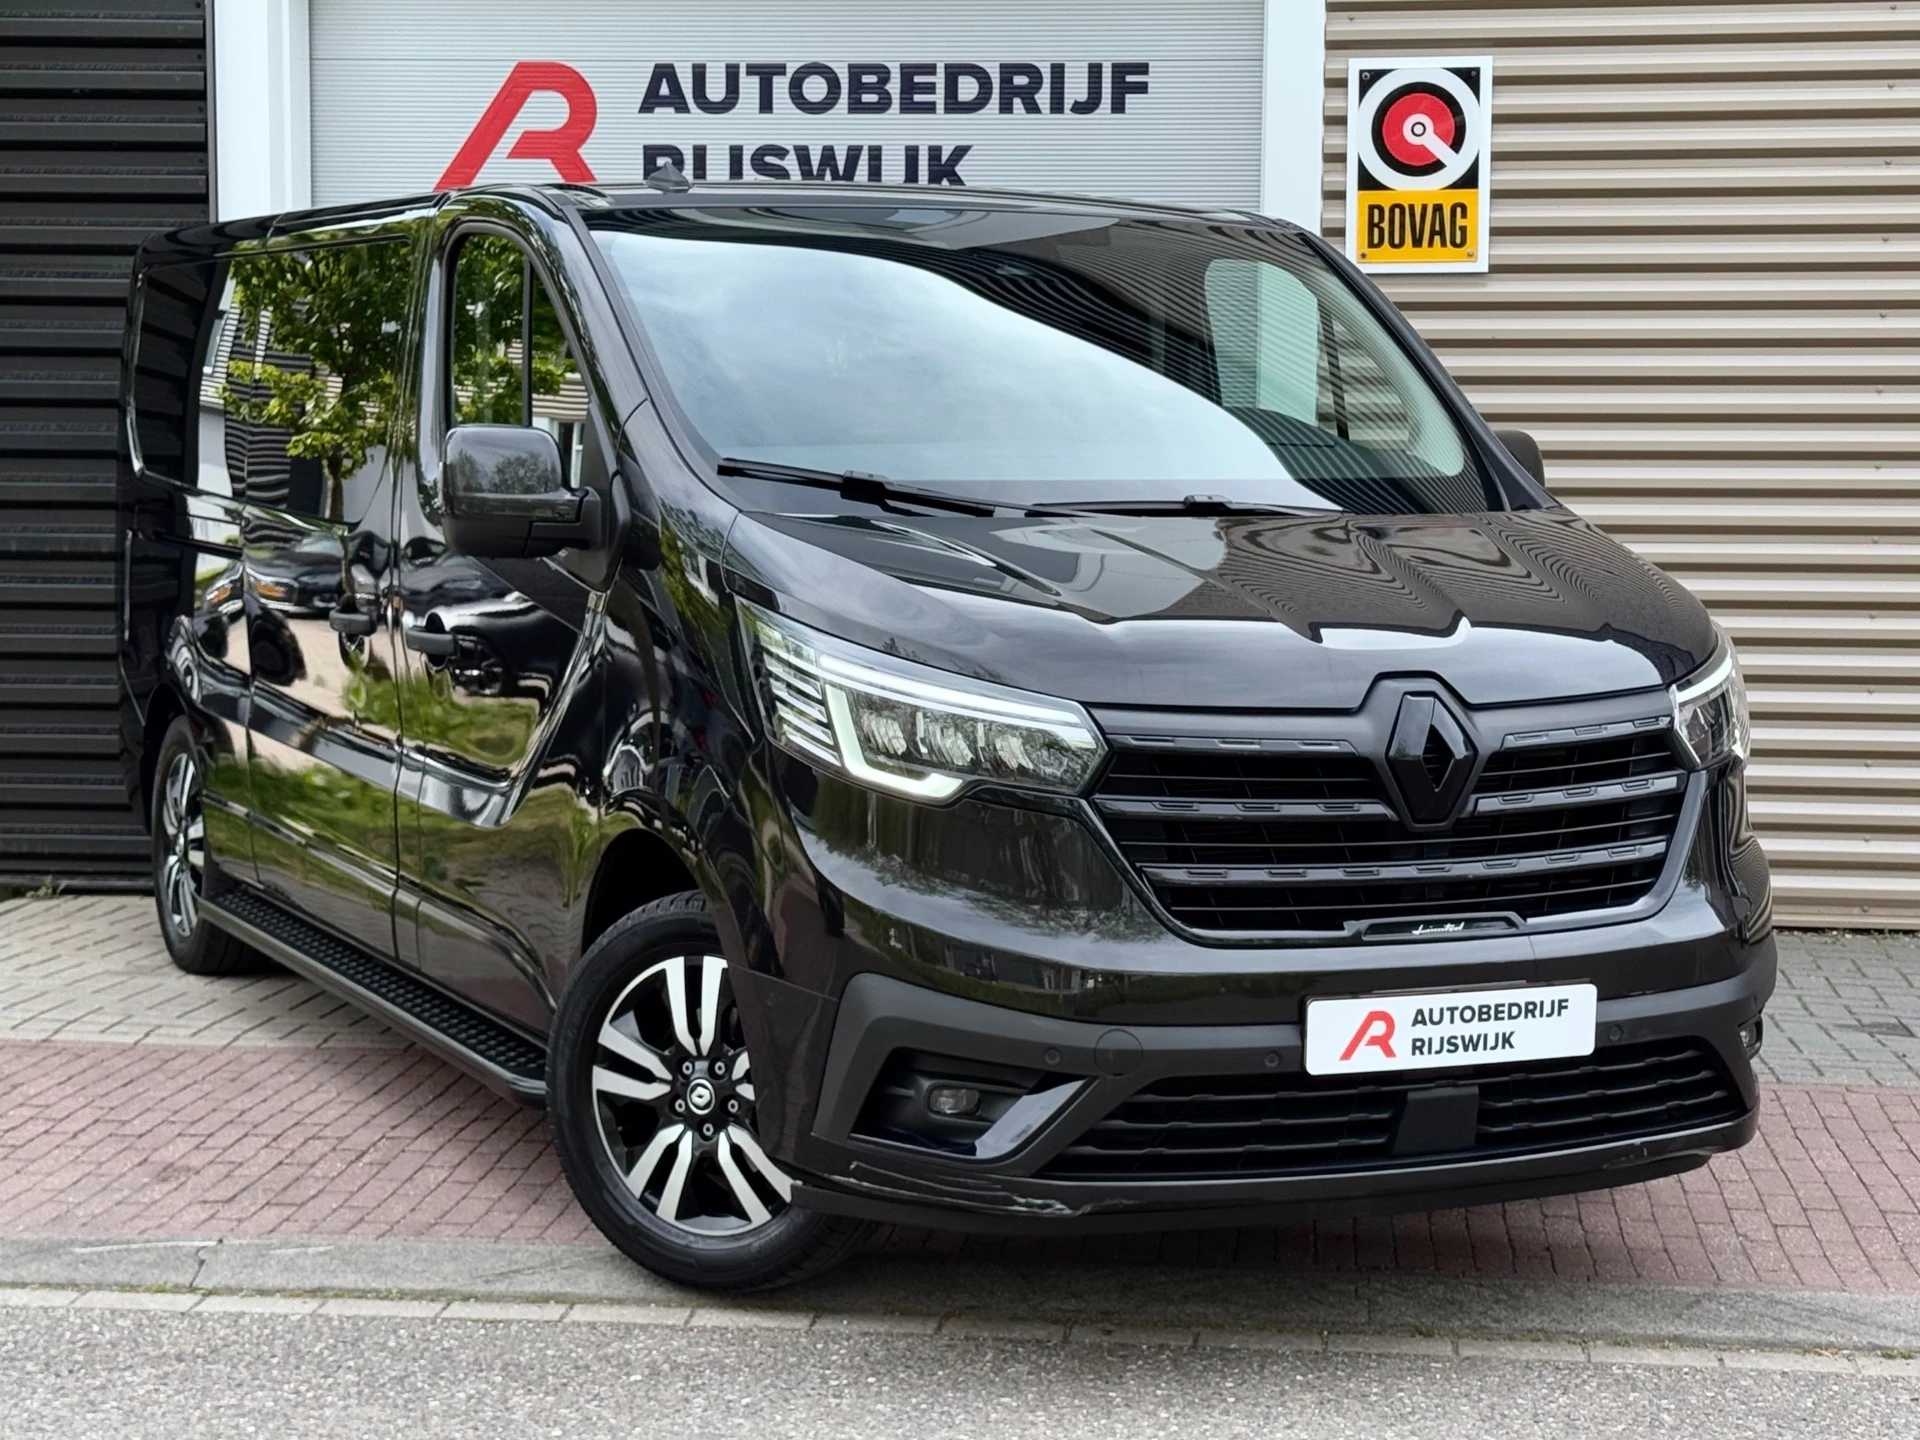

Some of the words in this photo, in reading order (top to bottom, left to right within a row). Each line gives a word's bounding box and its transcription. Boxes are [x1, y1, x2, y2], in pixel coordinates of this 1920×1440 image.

[637, 62, 1150, 115] AUTOBEDRIJF
[1366, 202, 1468, 250] BOVAG
[1411, 998, 1570, 1028] AUTOBEDRIJF
[1411, 1031, 1516, 1057] RIJSWIJK
